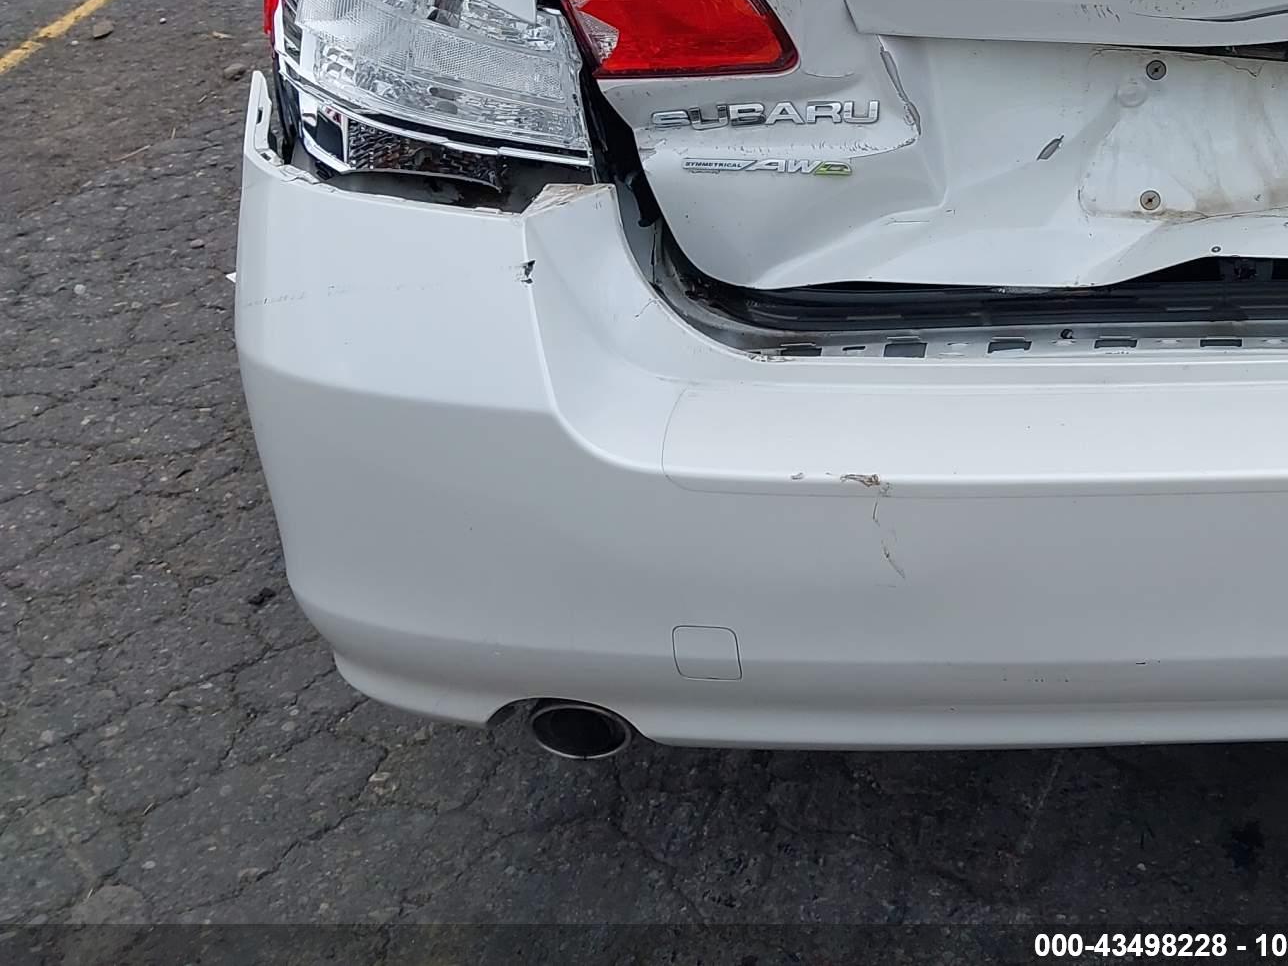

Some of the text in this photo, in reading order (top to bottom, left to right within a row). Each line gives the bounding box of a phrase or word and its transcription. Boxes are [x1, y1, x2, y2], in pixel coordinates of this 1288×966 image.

[651, 100, 880, 130] SUBARU
[684, 157, 852, 176] SYMMETRICAL AWD
